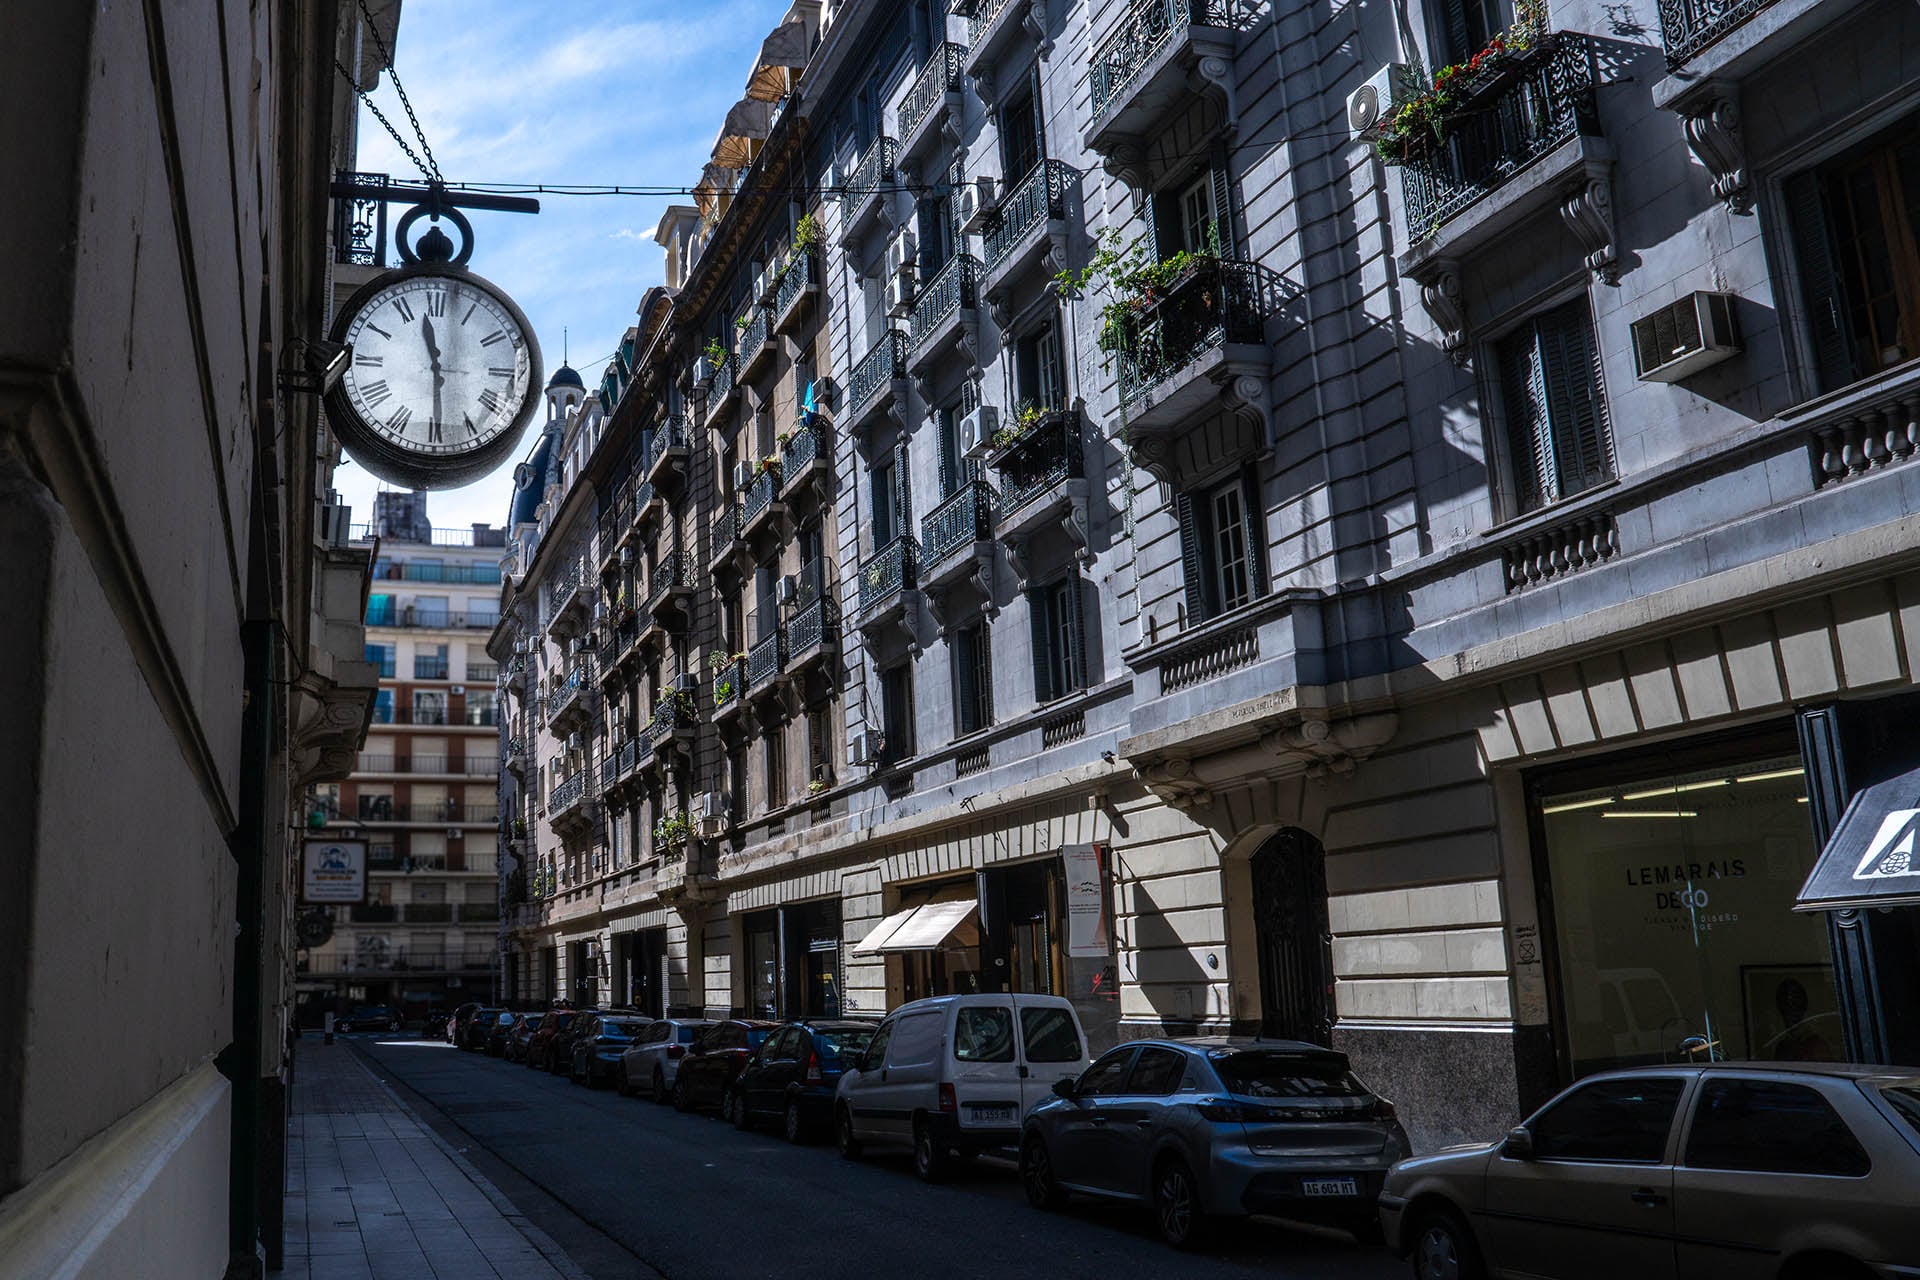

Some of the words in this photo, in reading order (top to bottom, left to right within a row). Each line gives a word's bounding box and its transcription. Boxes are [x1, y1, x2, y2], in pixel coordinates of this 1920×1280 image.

[392, 296, 415, 325] XI
[427, 292, 446, 318] XII
[366, 321, 392, 342] X
[480, 329, 507, 347] II
[355, 353, 384, 368] IX
[463, 411, 478, 437] V
[1626, 859, 1745, 886] LEMARAIS
[1306, 1183, 1318, 1194] AG
[1321, 1183, 1339, 1194] 601
